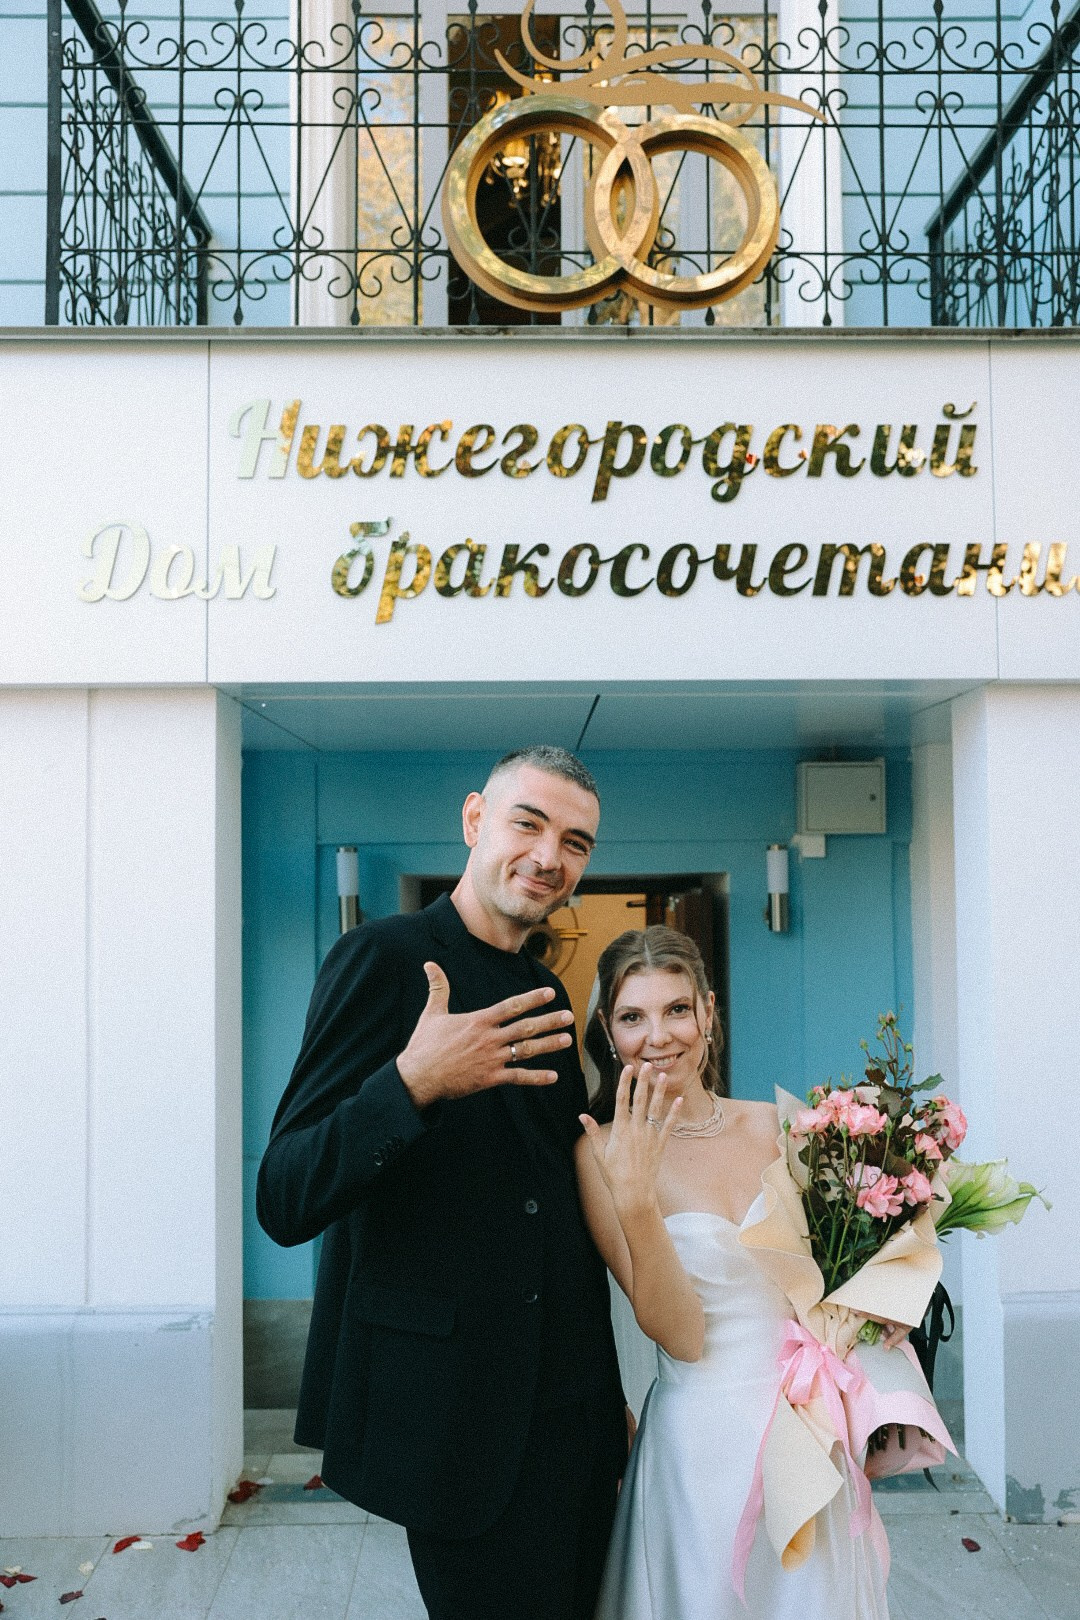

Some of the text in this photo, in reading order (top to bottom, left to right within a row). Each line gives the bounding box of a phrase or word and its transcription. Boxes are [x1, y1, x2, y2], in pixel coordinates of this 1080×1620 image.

[228, 398, 979, 503] Нижегородский
[77, 517, 1080, 625] Дом бракосочетани
